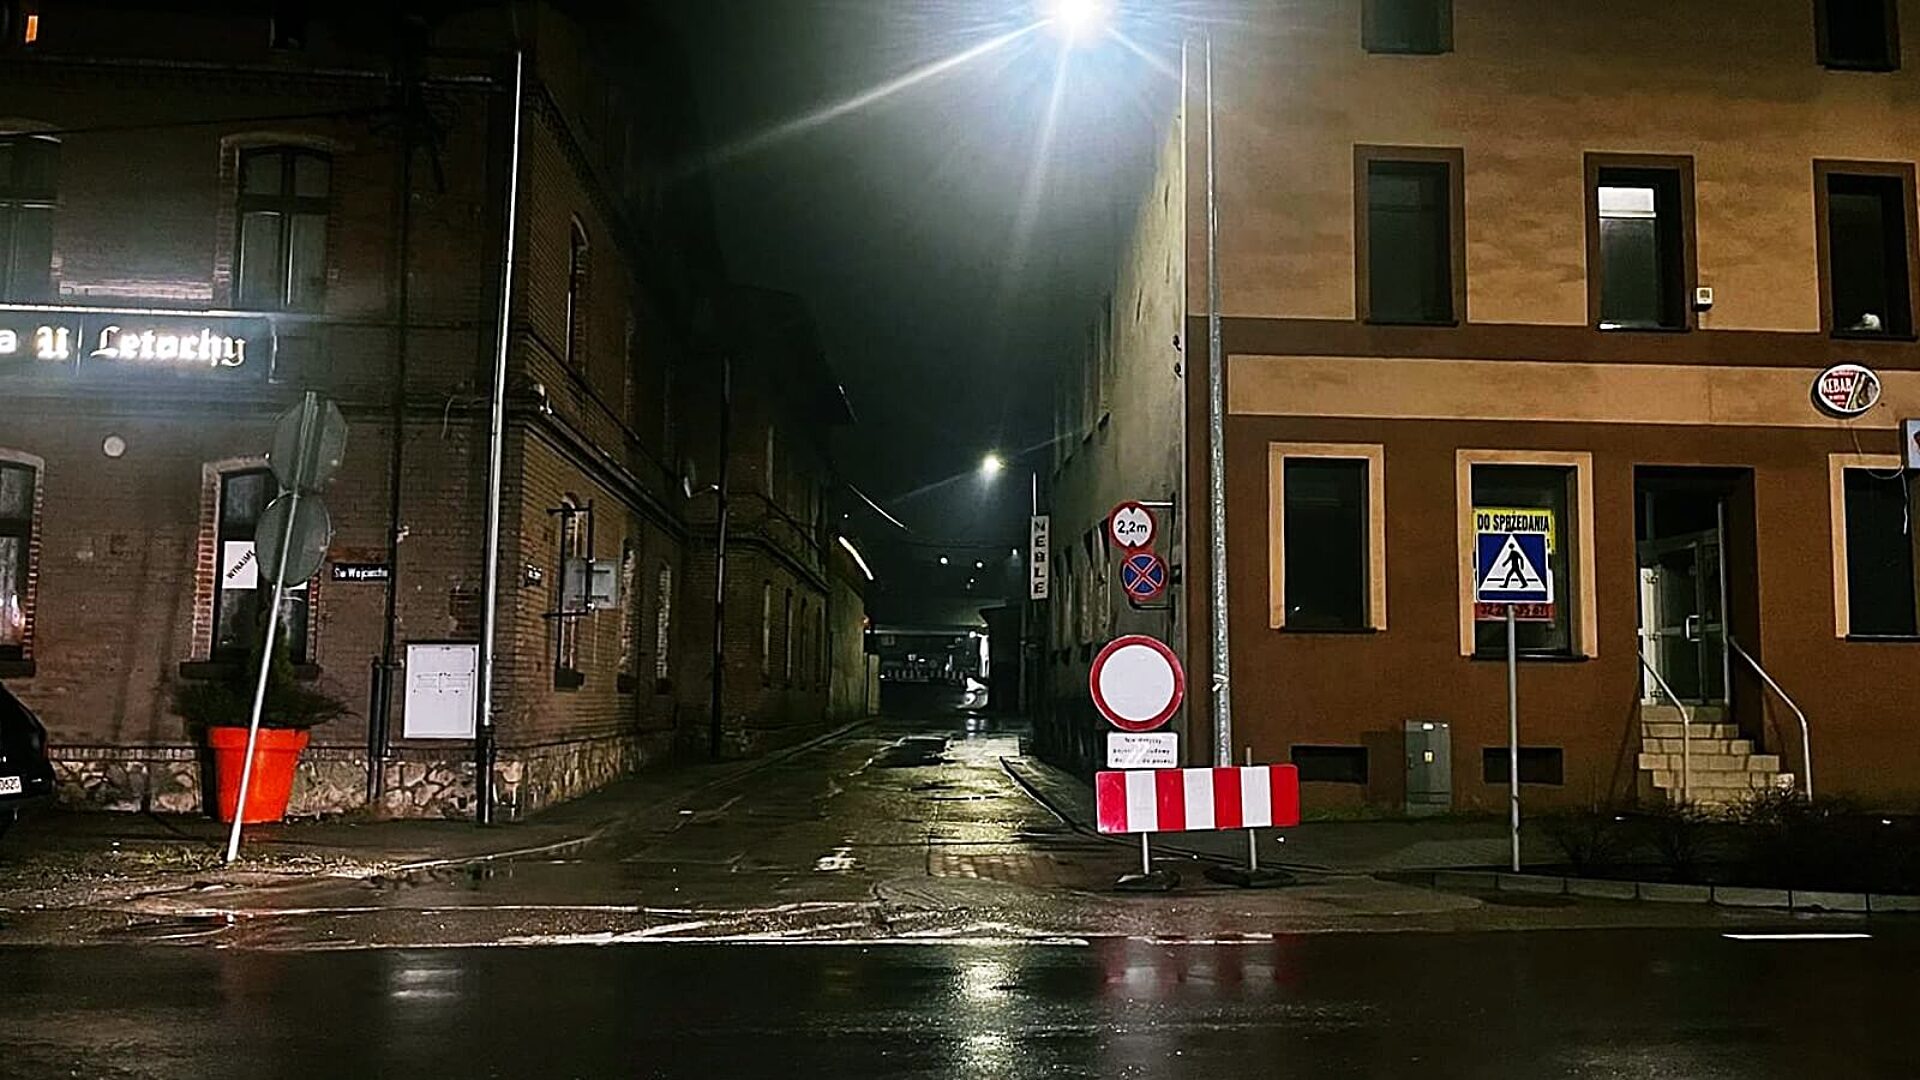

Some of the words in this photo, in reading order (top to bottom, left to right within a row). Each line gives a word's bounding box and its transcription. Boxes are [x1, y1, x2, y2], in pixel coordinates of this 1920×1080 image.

[1823, 377, 1853, 394] KEBAB
[1117, 519, 1148, 535] 2,2m
[1476, 513, 1491, 531] DO
[1492, 514, 1550, 532] SPRZEDANIA
